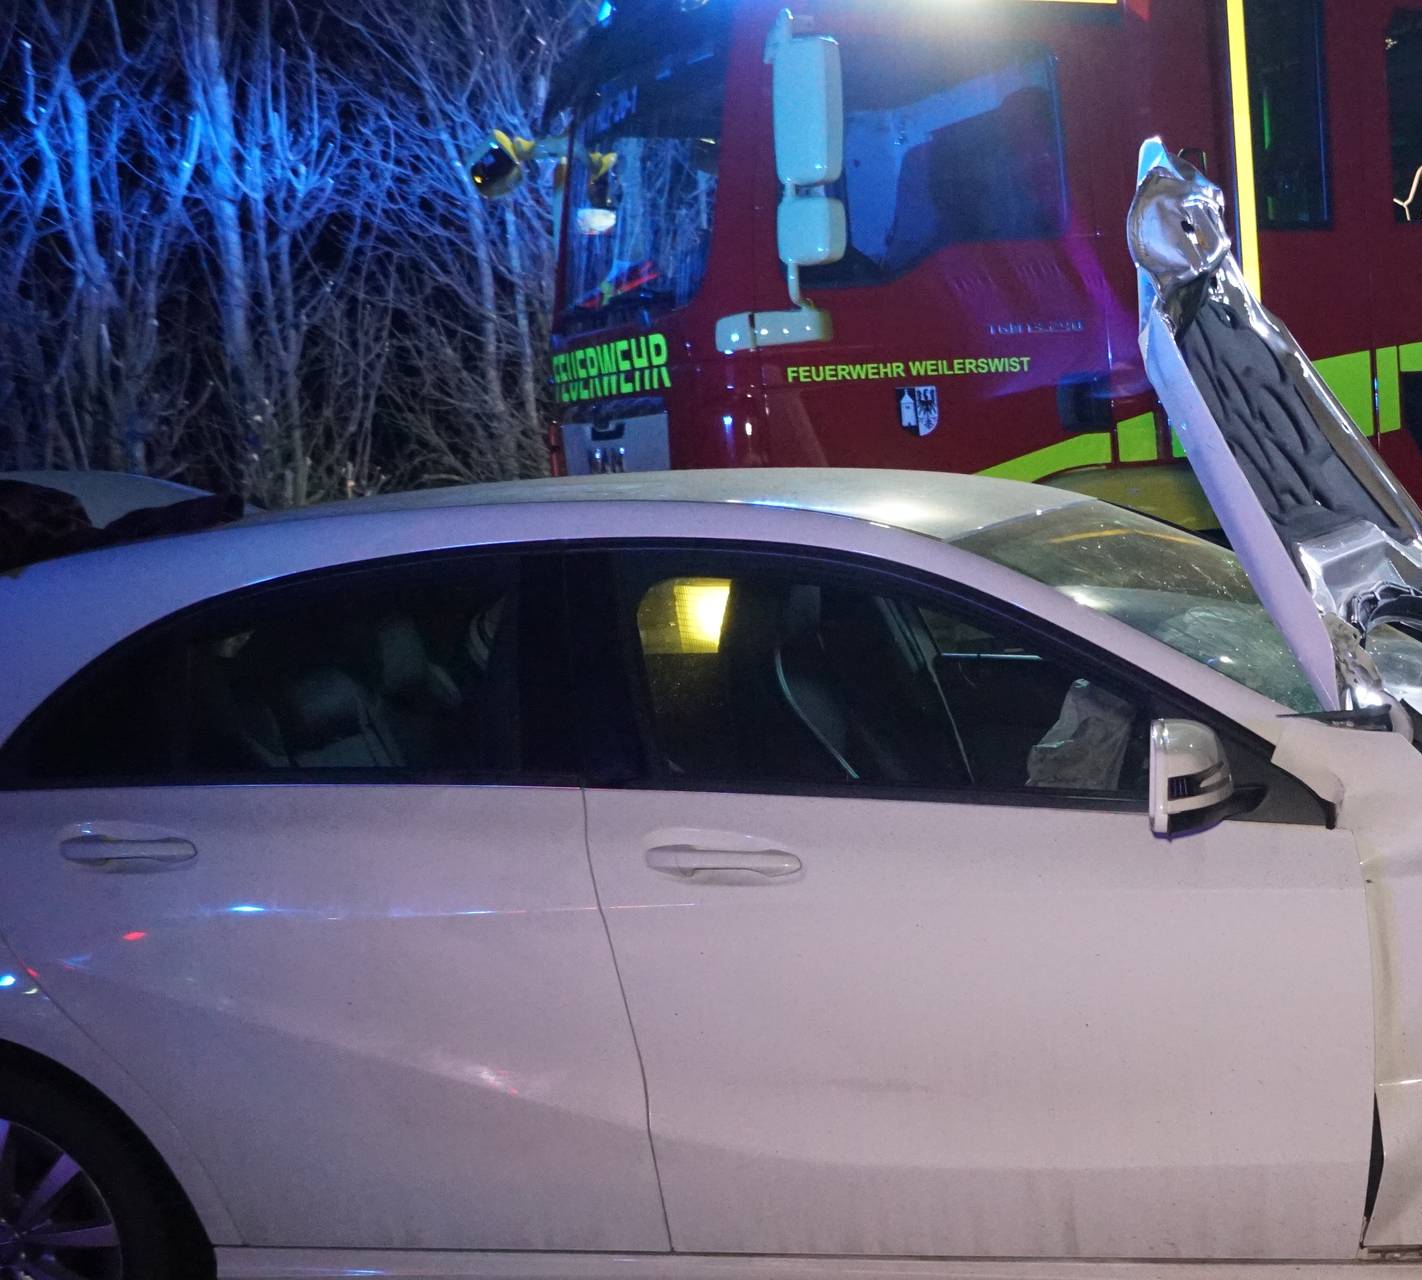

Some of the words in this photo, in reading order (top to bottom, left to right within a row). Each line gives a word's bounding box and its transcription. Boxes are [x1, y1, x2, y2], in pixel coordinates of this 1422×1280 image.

[551, 333, 671, 402] FEUERWEHR
[787, 362, 905, 383] FEUERWEHR
[909, 357, 1031, 376] WEILERSWIST
